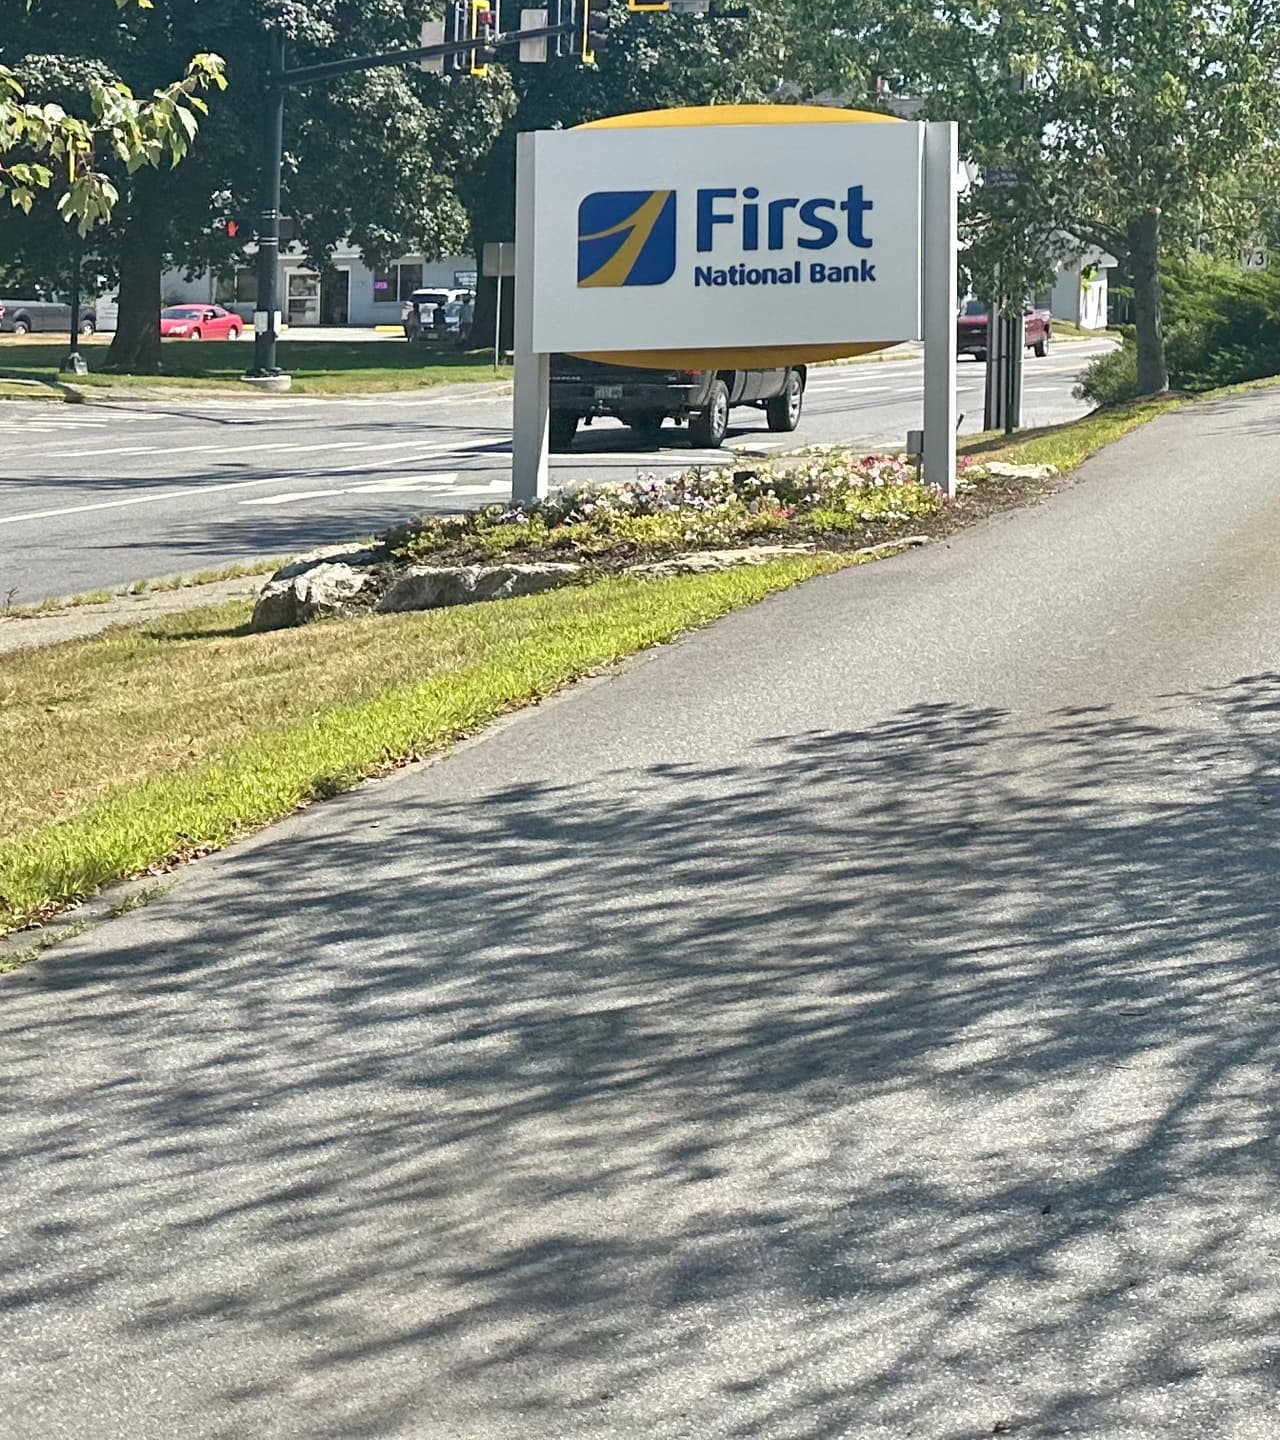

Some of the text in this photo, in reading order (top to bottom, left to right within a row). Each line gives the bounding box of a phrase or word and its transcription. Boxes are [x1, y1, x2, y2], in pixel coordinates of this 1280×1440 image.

[696, 184, 874, 253] First
[694, 259, 877, 287] National Bank
